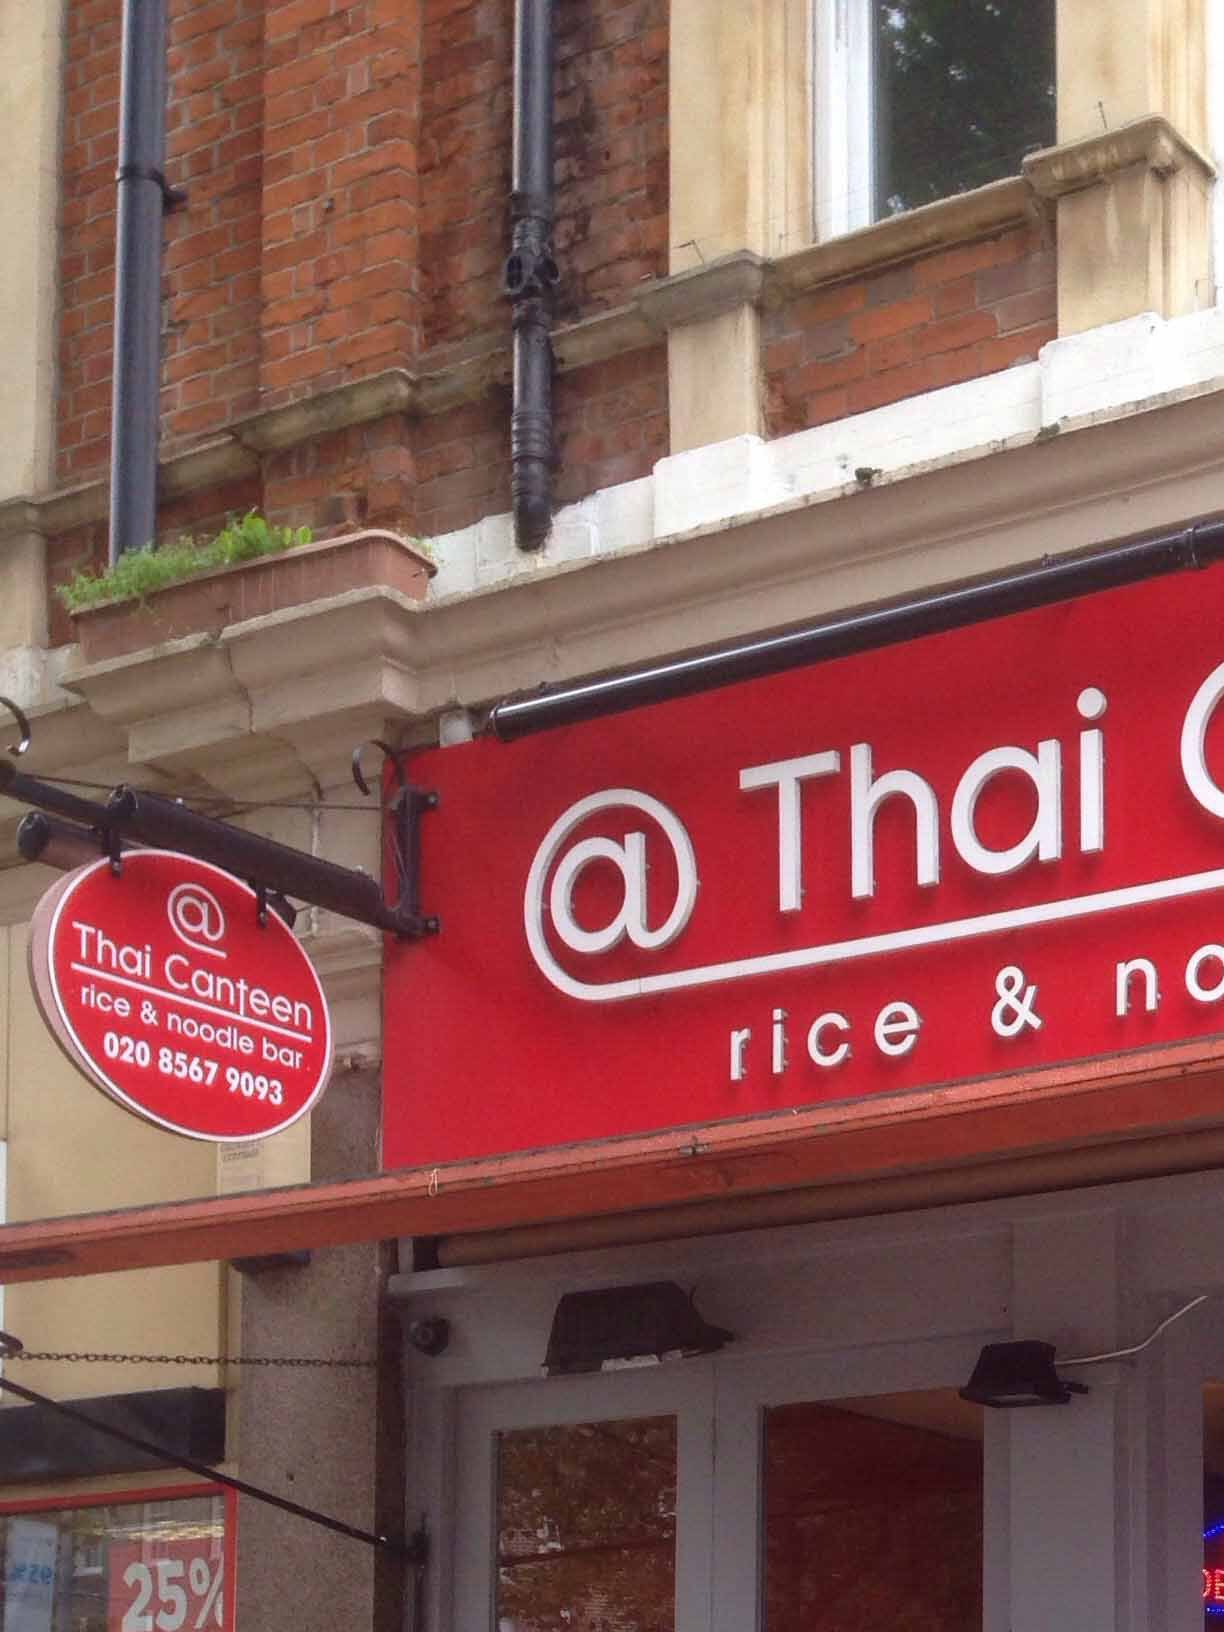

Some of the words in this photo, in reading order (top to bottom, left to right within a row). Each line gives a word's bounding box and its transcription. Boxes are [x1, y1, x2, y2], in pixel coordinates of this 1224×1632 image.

[523, 788, 700, 1000] @
[738, 687, 1107, 913] Thai
[168, 883, 227, 958] @
[72, 921, 152, 978] Thai
[164, 954, 313, 1029] Canteen
[730, 1001, 921, 1080] rice
[990, 965, 1041, 1038] &
[81, 984, 130, 1016] rice
[140, 1001, 158, 1026] &
[167, 1012, 254, 1055] noodle
[262, 1037, 302, 1069] bar
[103, 1031, 150, 1067] 020
[158, 1047, 218, 1086] 8567
[226, 1068, 283, 1104] 9093
